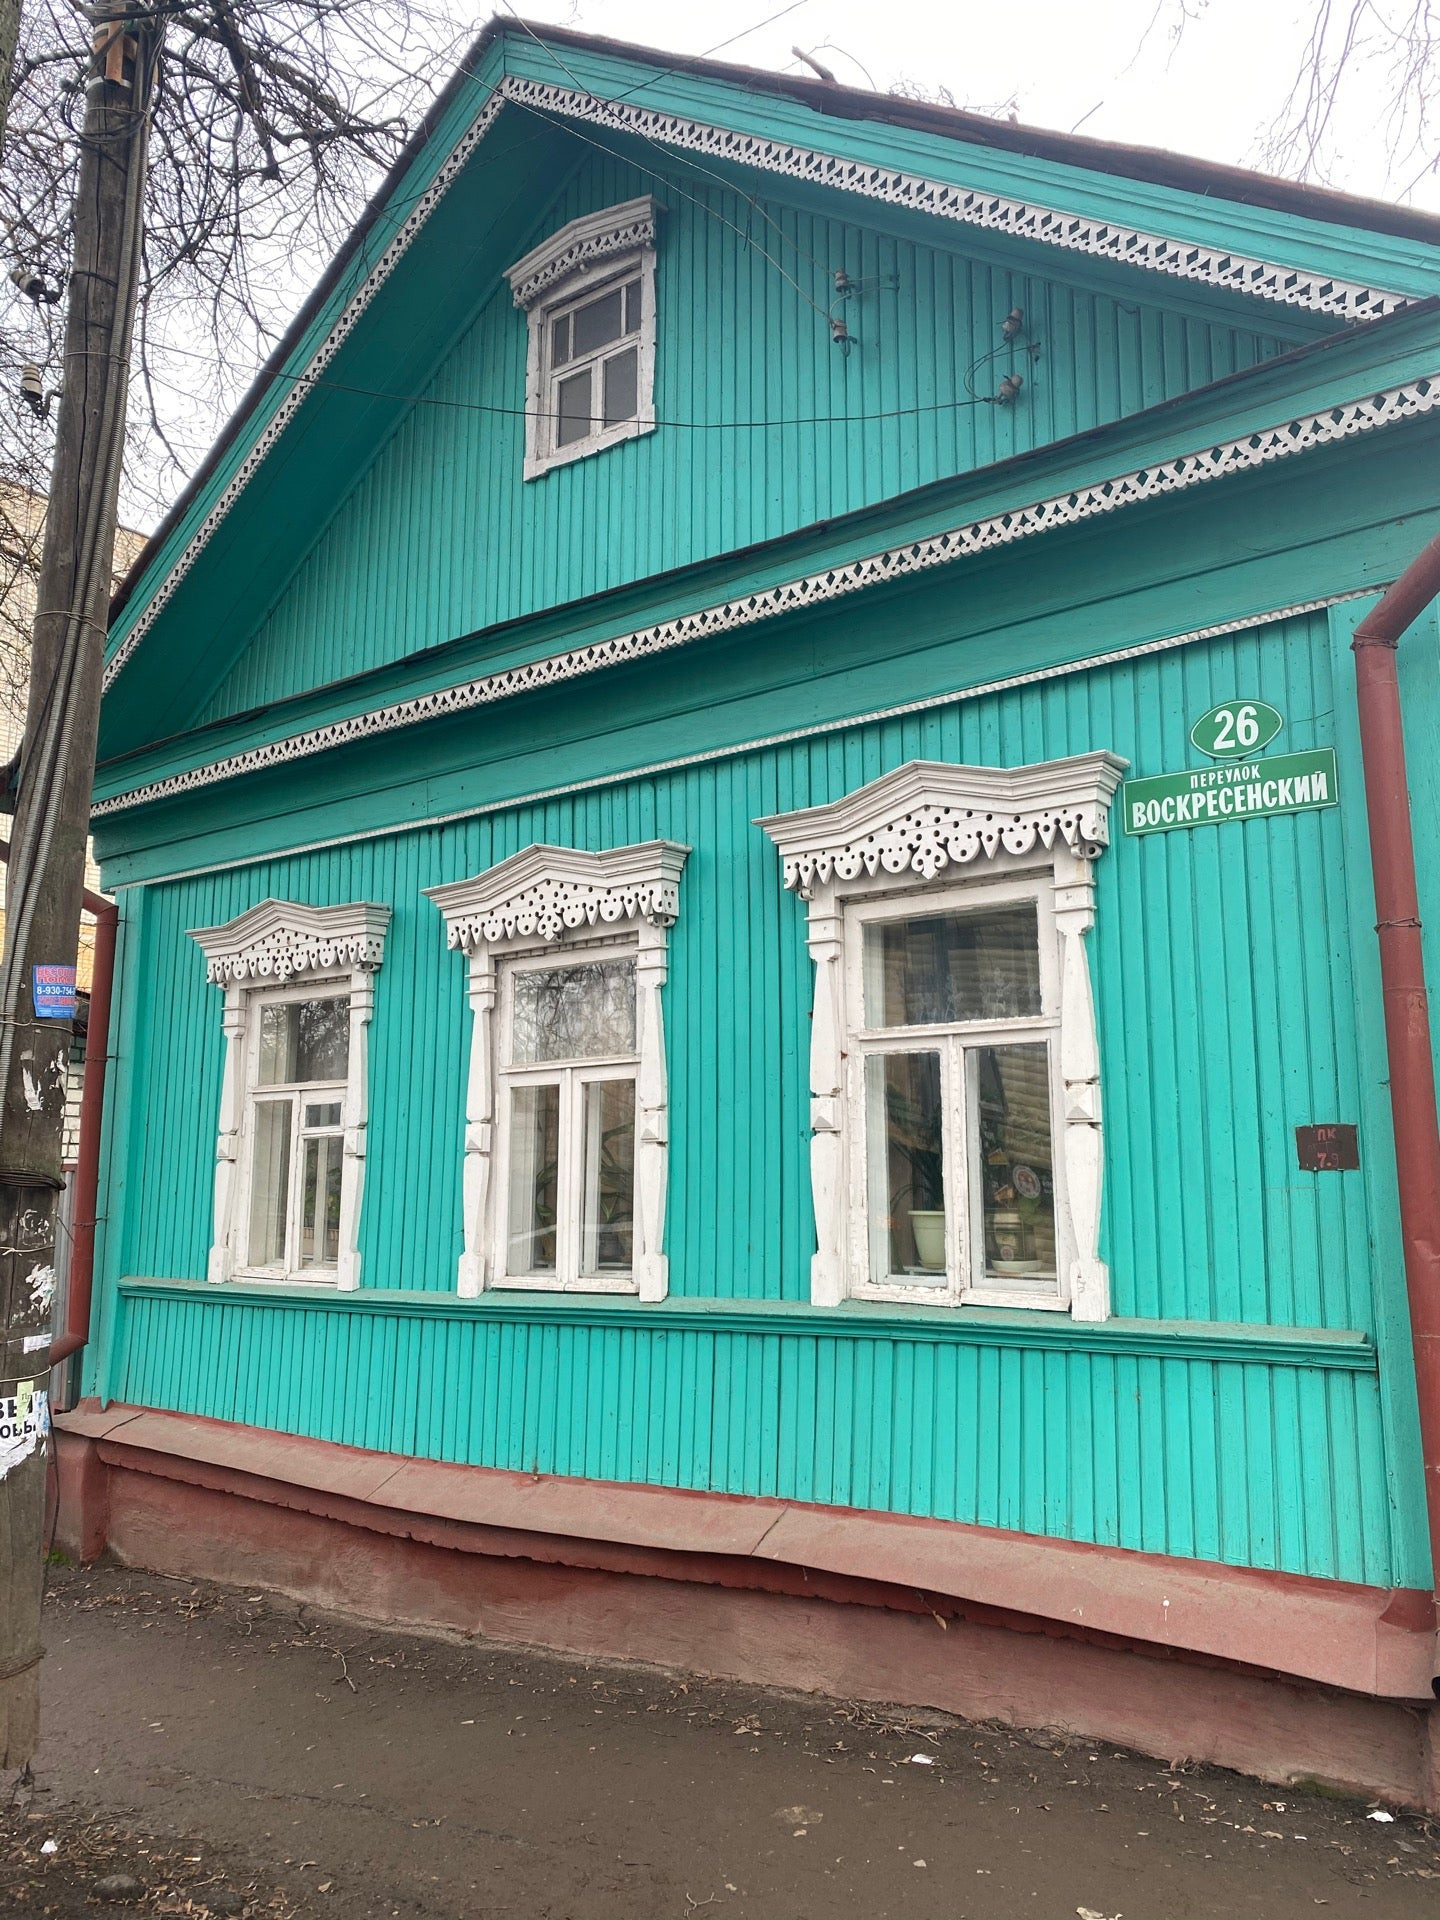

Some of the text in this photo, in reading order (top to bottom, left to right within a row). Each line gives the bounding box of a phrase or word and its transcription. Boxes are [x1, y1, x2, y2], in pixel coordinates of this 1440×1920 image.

[1213, 705, 1259, 750] 26
[1190, 764, 1261, 789] ПЕРЕУЛОК
[1132, 771, 1328, 828] ВОСКРЕСЕНСКИЙ
